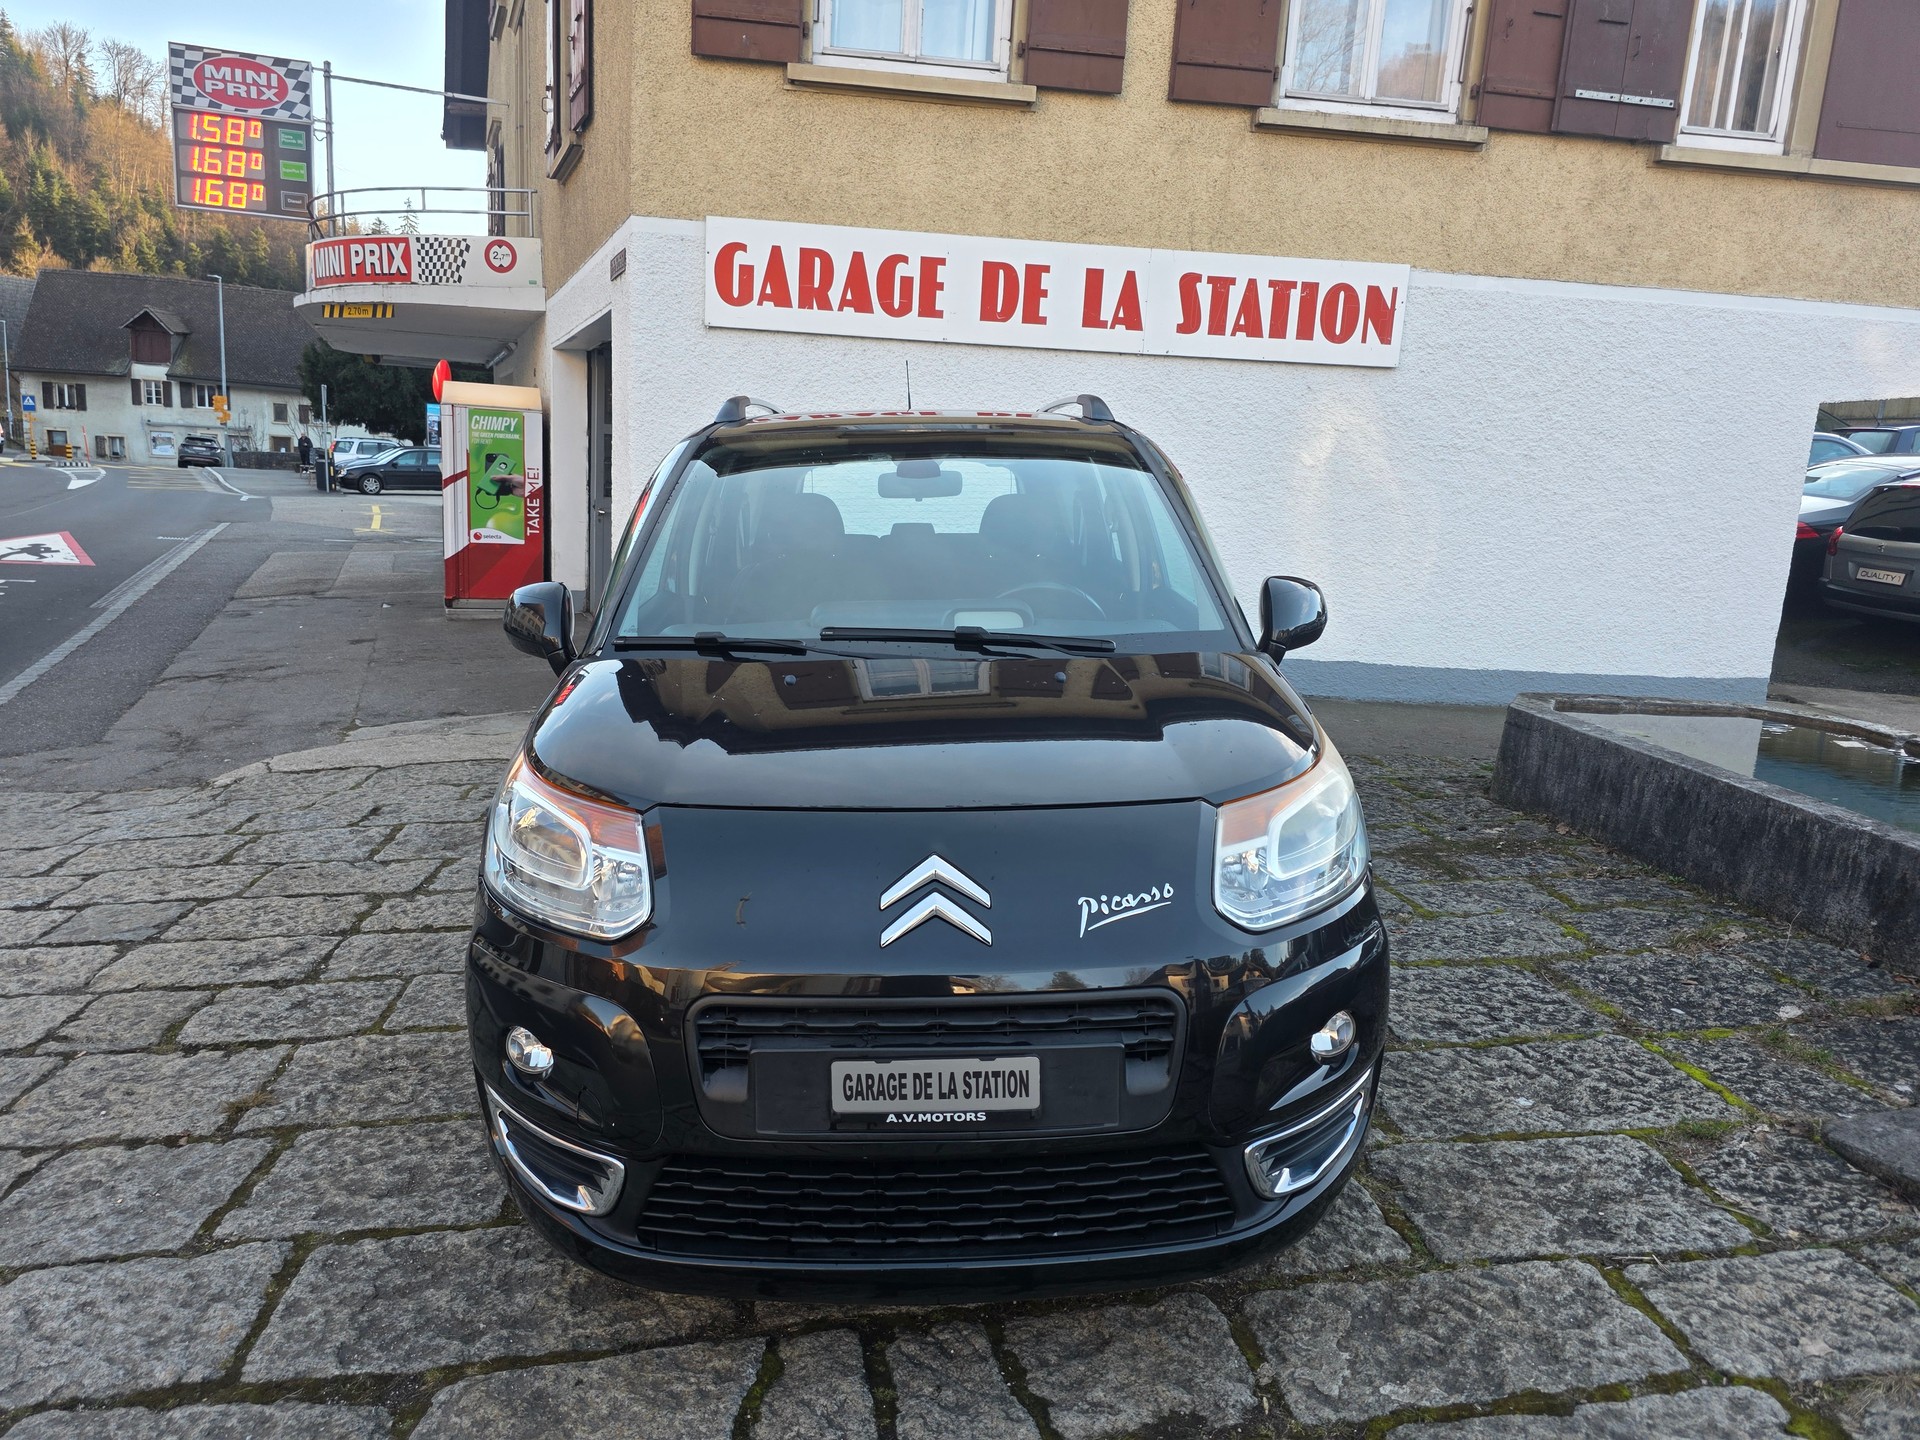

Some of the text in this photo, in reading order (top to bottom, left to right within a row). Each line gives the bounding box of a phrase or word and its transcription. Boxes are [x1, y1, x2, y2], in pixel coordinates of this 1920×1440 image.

[204, 64, 278, 87] MINI
[205, 80, 280, 102] PRIX
[315, 243, 408, 279] MINI PRIX
[714, 242, 1398, 345] GARAGE DE LA STATION
[471, 415, 518, 431] CHIMPY
[527, 467, 540, 536] TAKE ME!
[1860, 570, 1896, 582] QUALITY
[1077, 882, 1174, 938] Picasso
[842, 1070, 1030, 1101] GARAGE DE LA STATION
[886, 1112, 987, 1123] A.V.MOTORS
